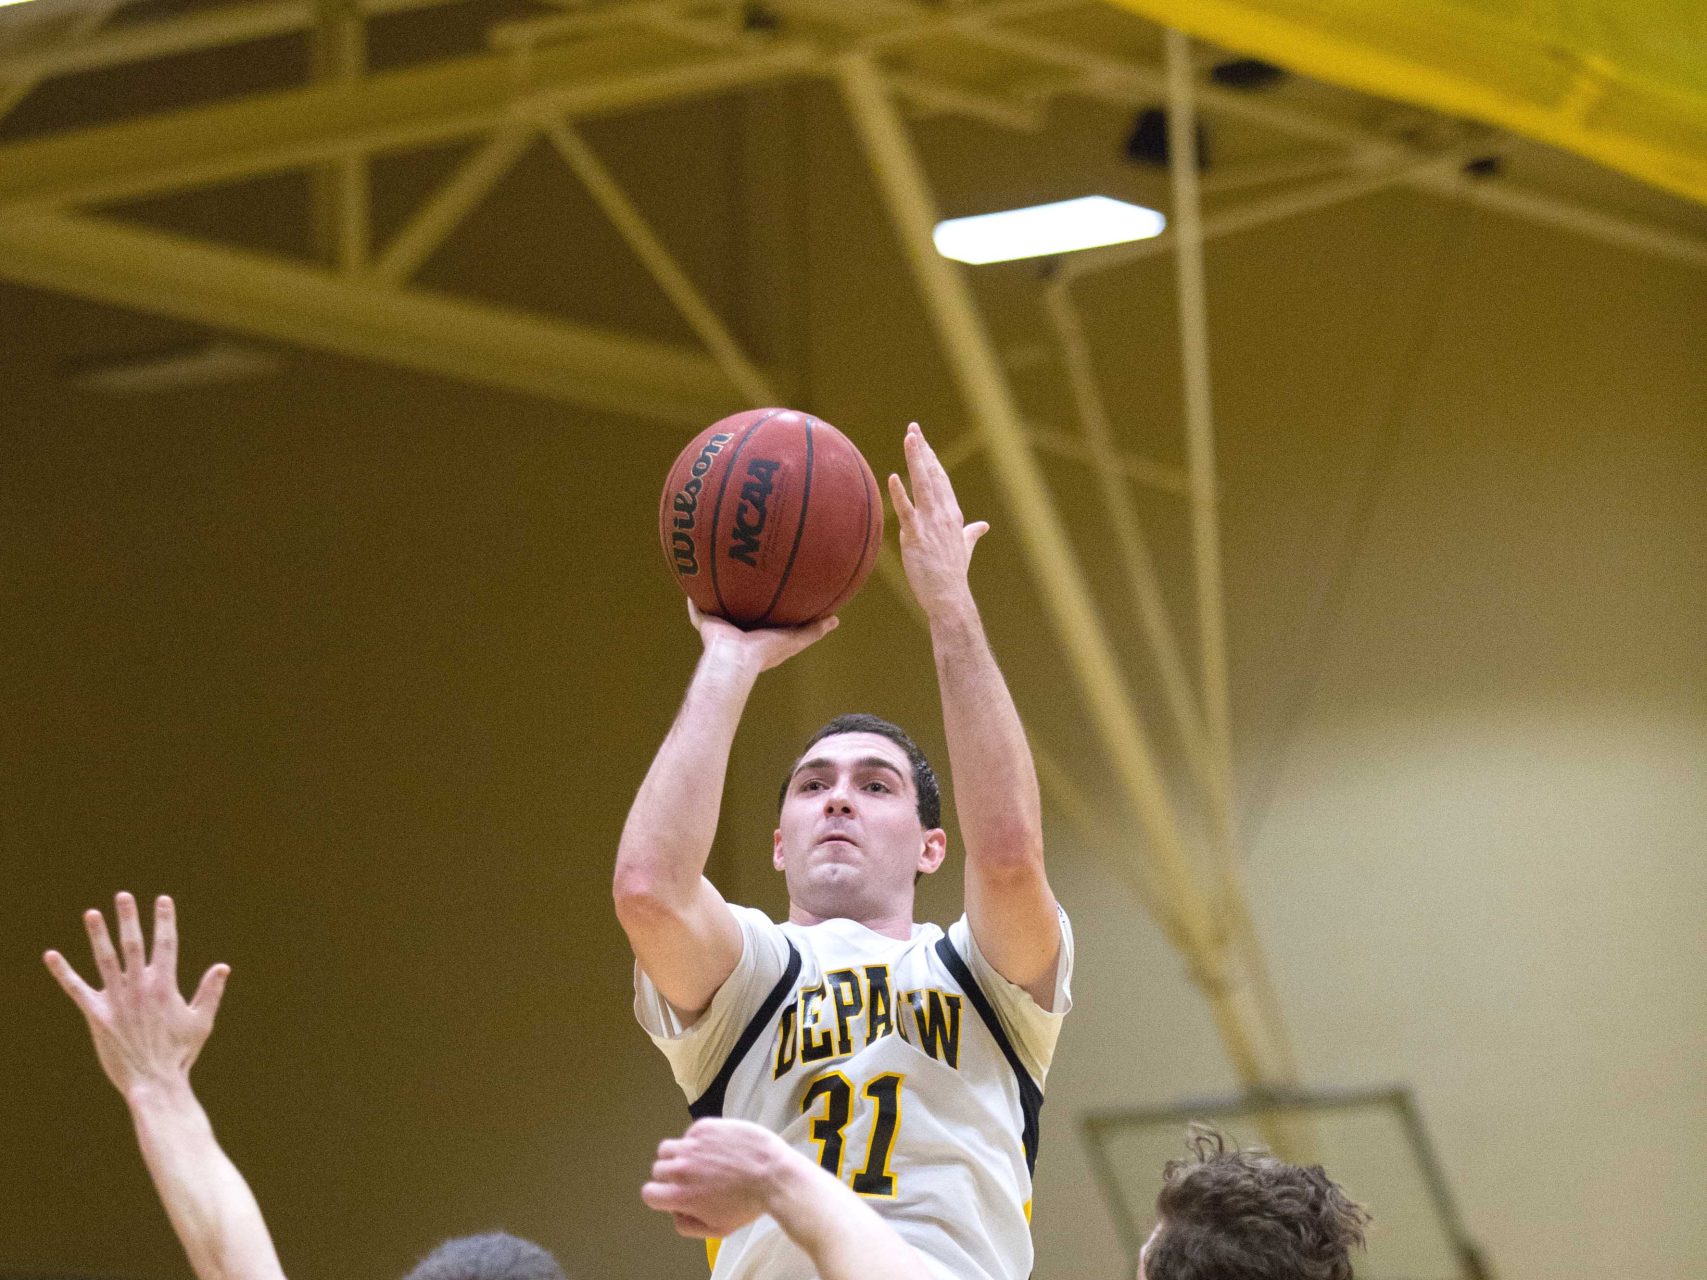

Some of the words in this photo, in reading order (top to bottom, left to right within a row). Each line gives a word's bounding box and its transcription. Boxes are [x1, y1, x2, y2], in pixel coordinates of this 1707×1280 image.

[672, 431, 735, 577] Wilson
[727, 458, 781, 568] NCAA
[773, 963, 964, 1082] DEPAW
[801, 1070, 905, 1199] 31
